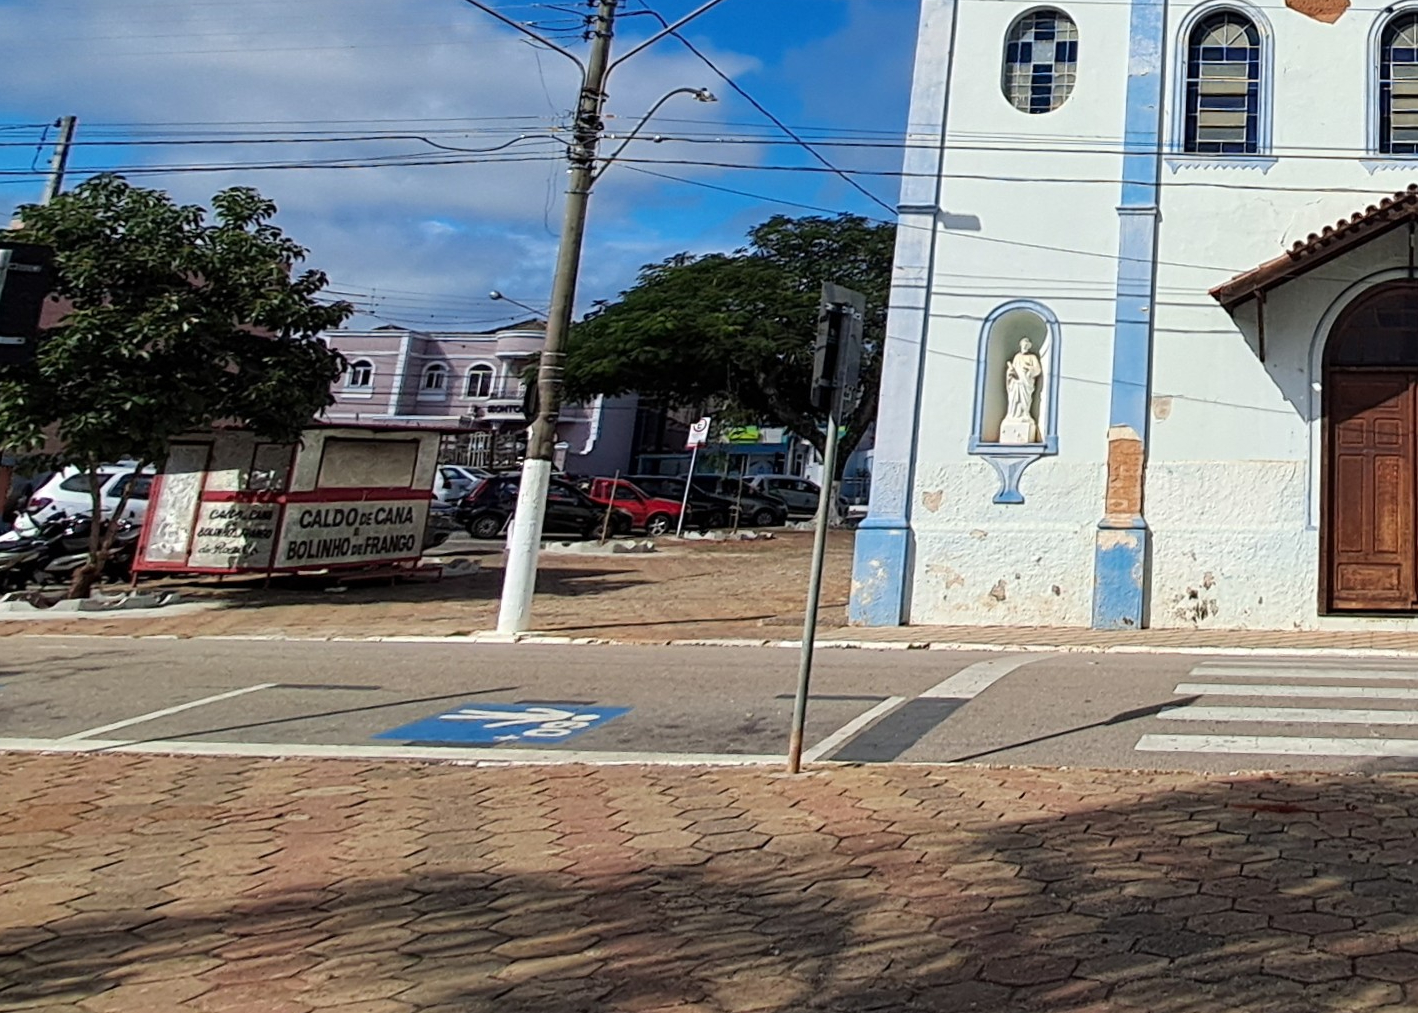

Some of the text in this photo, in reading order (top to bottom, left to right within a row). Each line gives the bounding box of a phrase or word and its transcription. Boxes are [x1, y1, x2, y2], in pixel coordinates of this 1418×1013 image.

[300, 506, 413, 529] CALDO DE CANA
[286, 534, 416, 561] BOLINHO DE FRANGO
